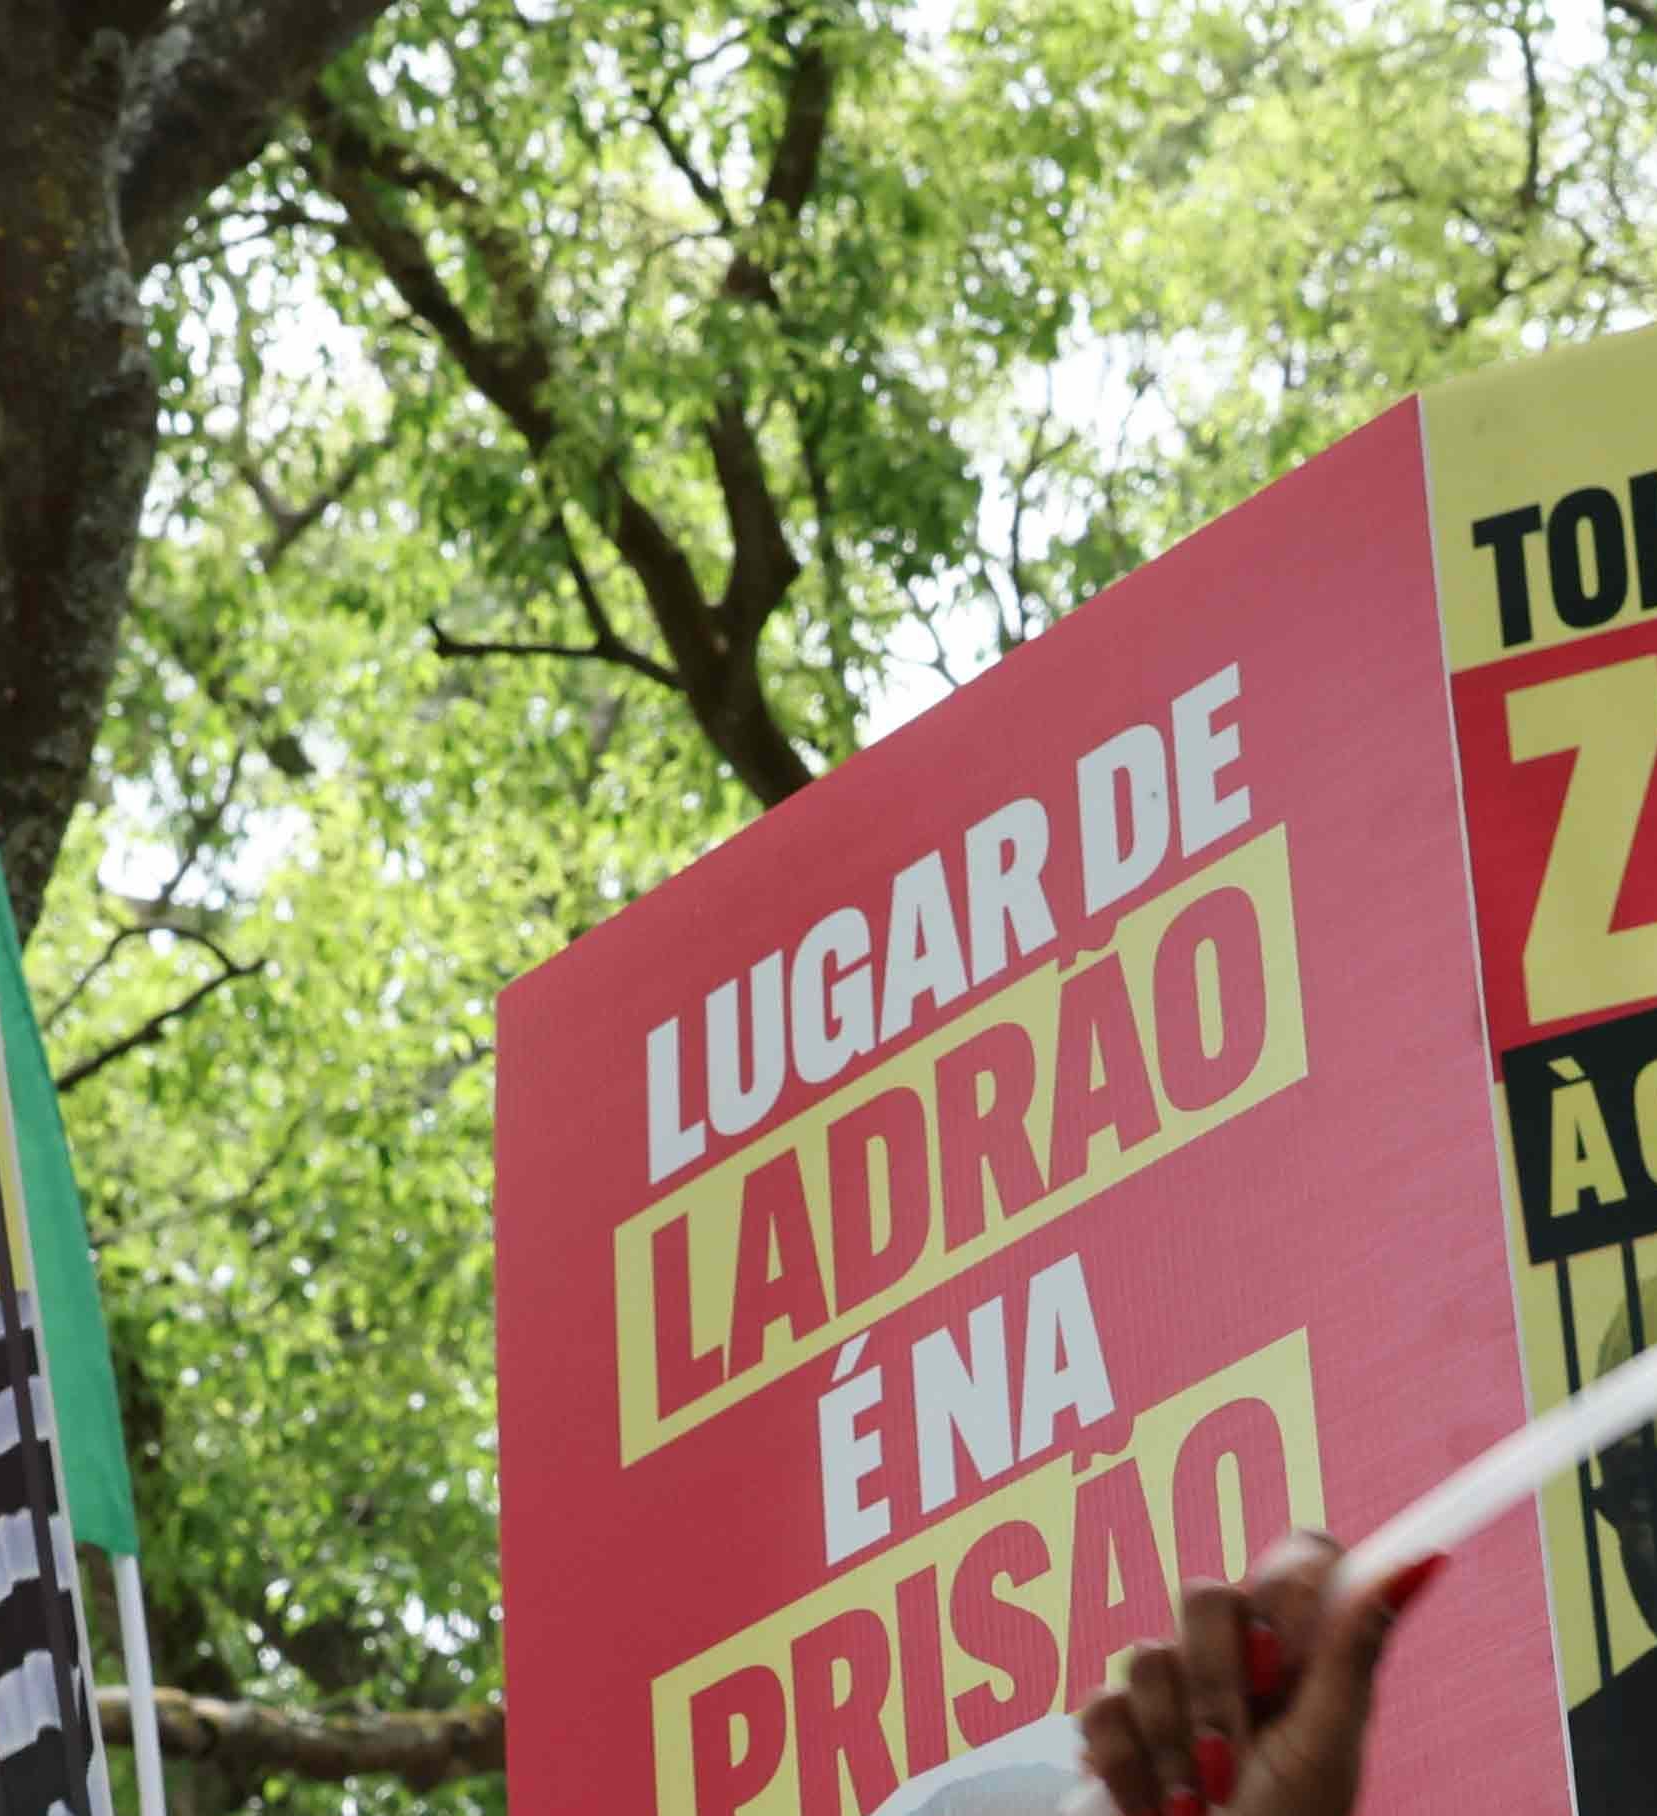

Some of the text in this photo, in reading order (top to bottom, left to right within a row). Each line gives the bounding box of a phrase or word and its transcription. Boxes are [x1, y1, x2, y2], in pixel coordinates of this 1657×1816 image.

[646, 661, 1252, 1186] LUGAR DE
[651, 885, 1268, 1424] LADRÃO
[1549, 1056, 1627, 1218] À
[817, 1252, 1115, 1567] É NA
